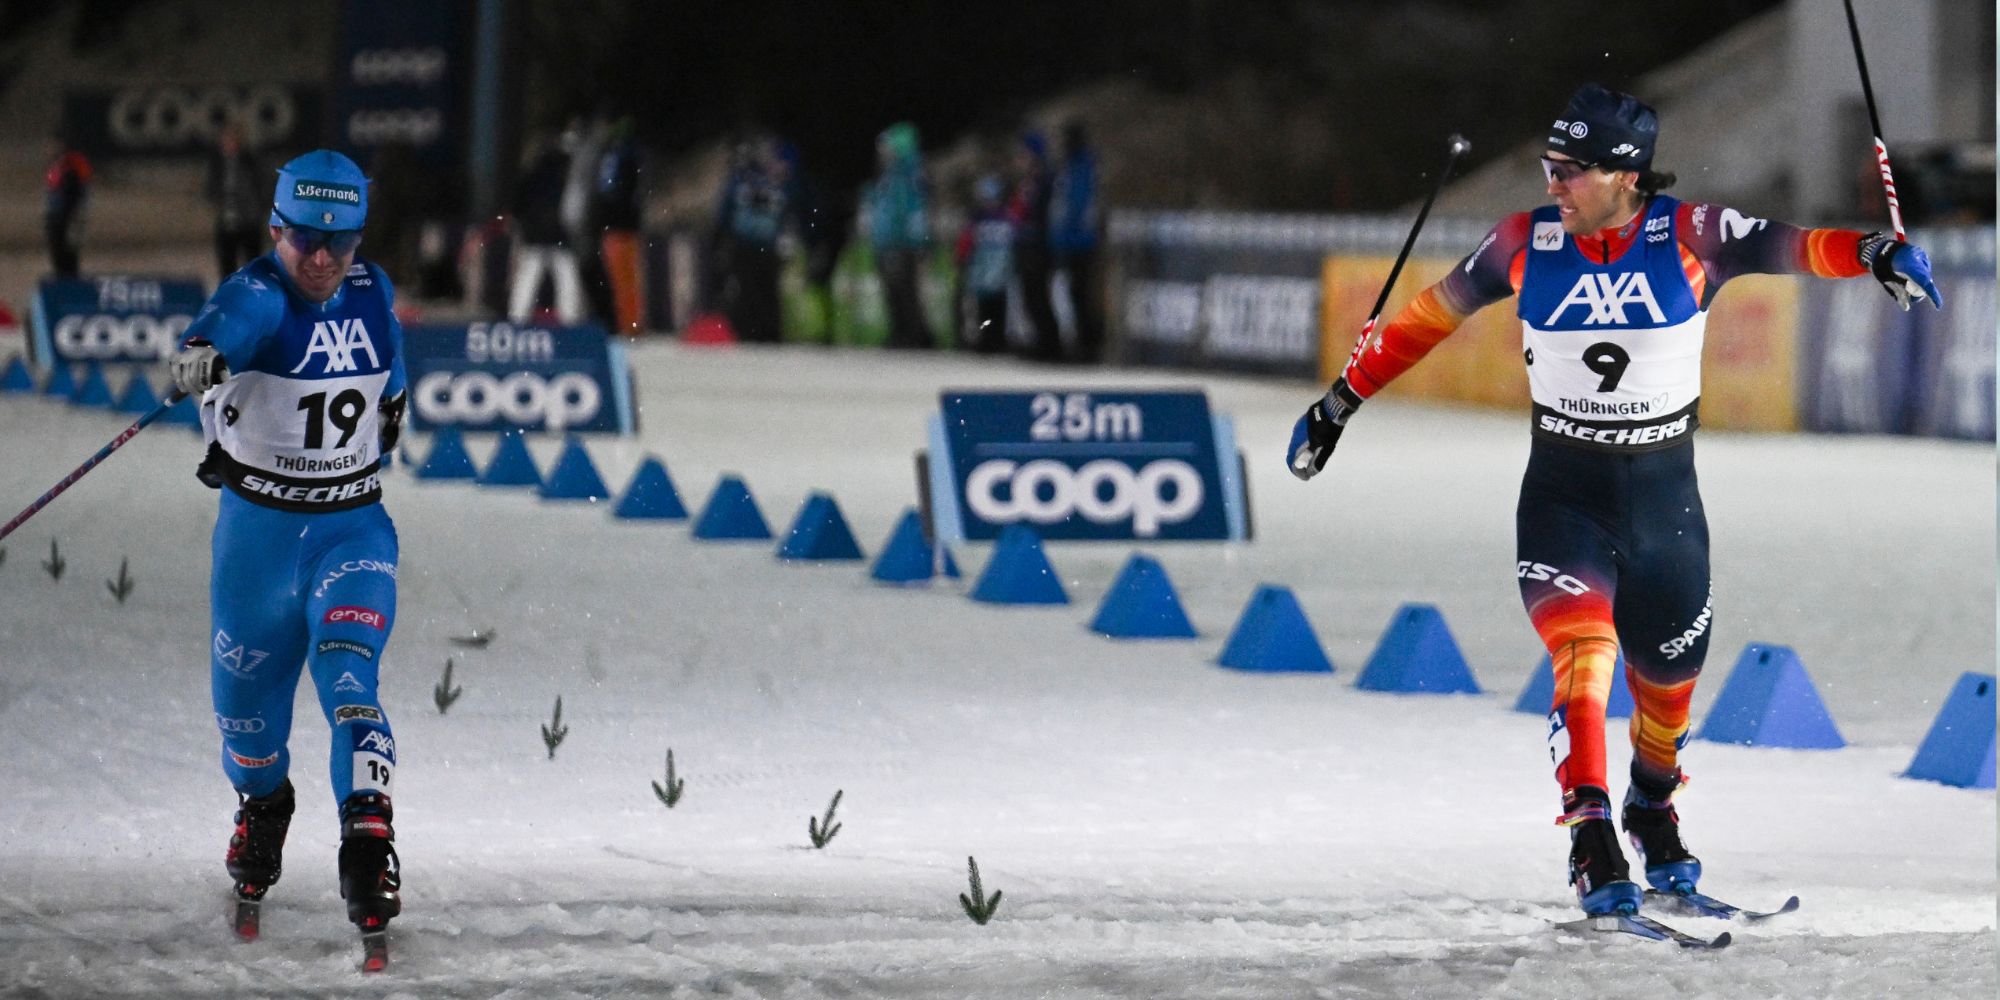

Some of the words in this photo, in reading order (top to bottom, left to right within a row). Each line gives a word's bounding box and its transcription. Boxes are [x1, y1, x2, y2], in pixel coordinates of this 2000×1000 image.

[295, 184, 359, 202] S.Bernardo
[1544, 272, 1668, 326] AXA
[290, 318, 380, 373] AXA
[466, 321, 554, 363] 50m
[1581, 341, 1631, 392] 9
[297, 389, 366, 449] 19
[414, 370, 602, 430] coop
[1029, 393, 1143, 441] 25m
[1559, 398, 1650, 416] THÜRINGEN
[1540, 414, 1690, 445] SKECHERS
[275, 452, 357, 473] THÜRINGEN
[965, 458, 1204, 537] coop
[330, 610, 379, 626] enel
[214, 629, 270, 672] EA7
[358, 730, 396, 760] AXA
[367, 760, 389, 786] 19
